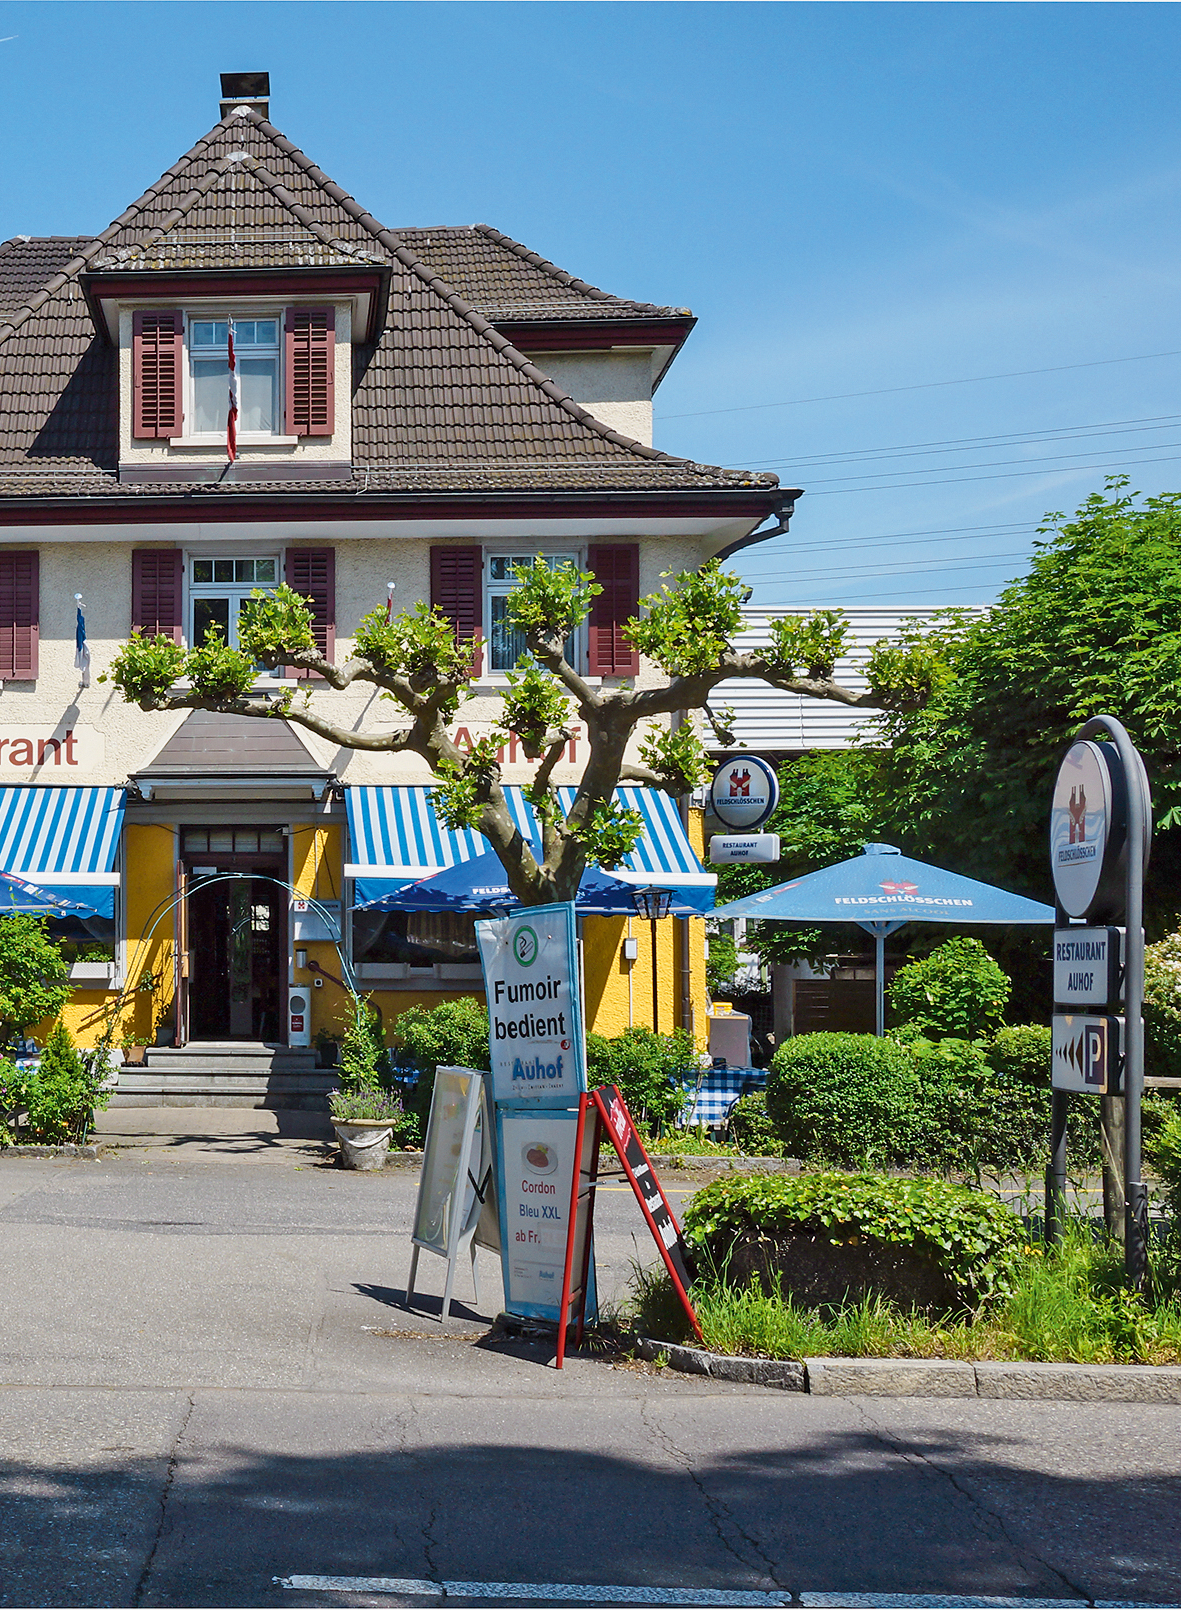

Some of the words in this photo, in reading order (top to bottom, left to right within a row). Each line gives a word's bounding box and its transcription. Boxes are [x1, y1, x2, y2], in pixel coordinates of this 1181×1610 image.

[716, 797, 765, 805] FELDSCHLÖSSCHEN
[1058, 845, 1097, 863] FELDSCHLÖSSCHEN
[834, 894, 974, 907] FELDSCHLÖSSCHEN
[901, 906, 950, 915] ALCOOL
[1056, 941, 1106, 961] RESTAURANT
[494, 975, 562, 1004] Fumoir
[1067, 972, 1094, 991] AUHOF
[495, 1011, 566, 1040] bedient
[1089, 1032, 1102, 1078] P
[512, 1055, 564, 1081] Auhof
[522, 1180, 556, 1195] Cordon
[519, 1204, 539, 1218] Bleu
[541, 1205, 561, 1220] XXL
[515, 1230, 526, 1242] ab
[528, 1230, 541, 1244] Fr.
